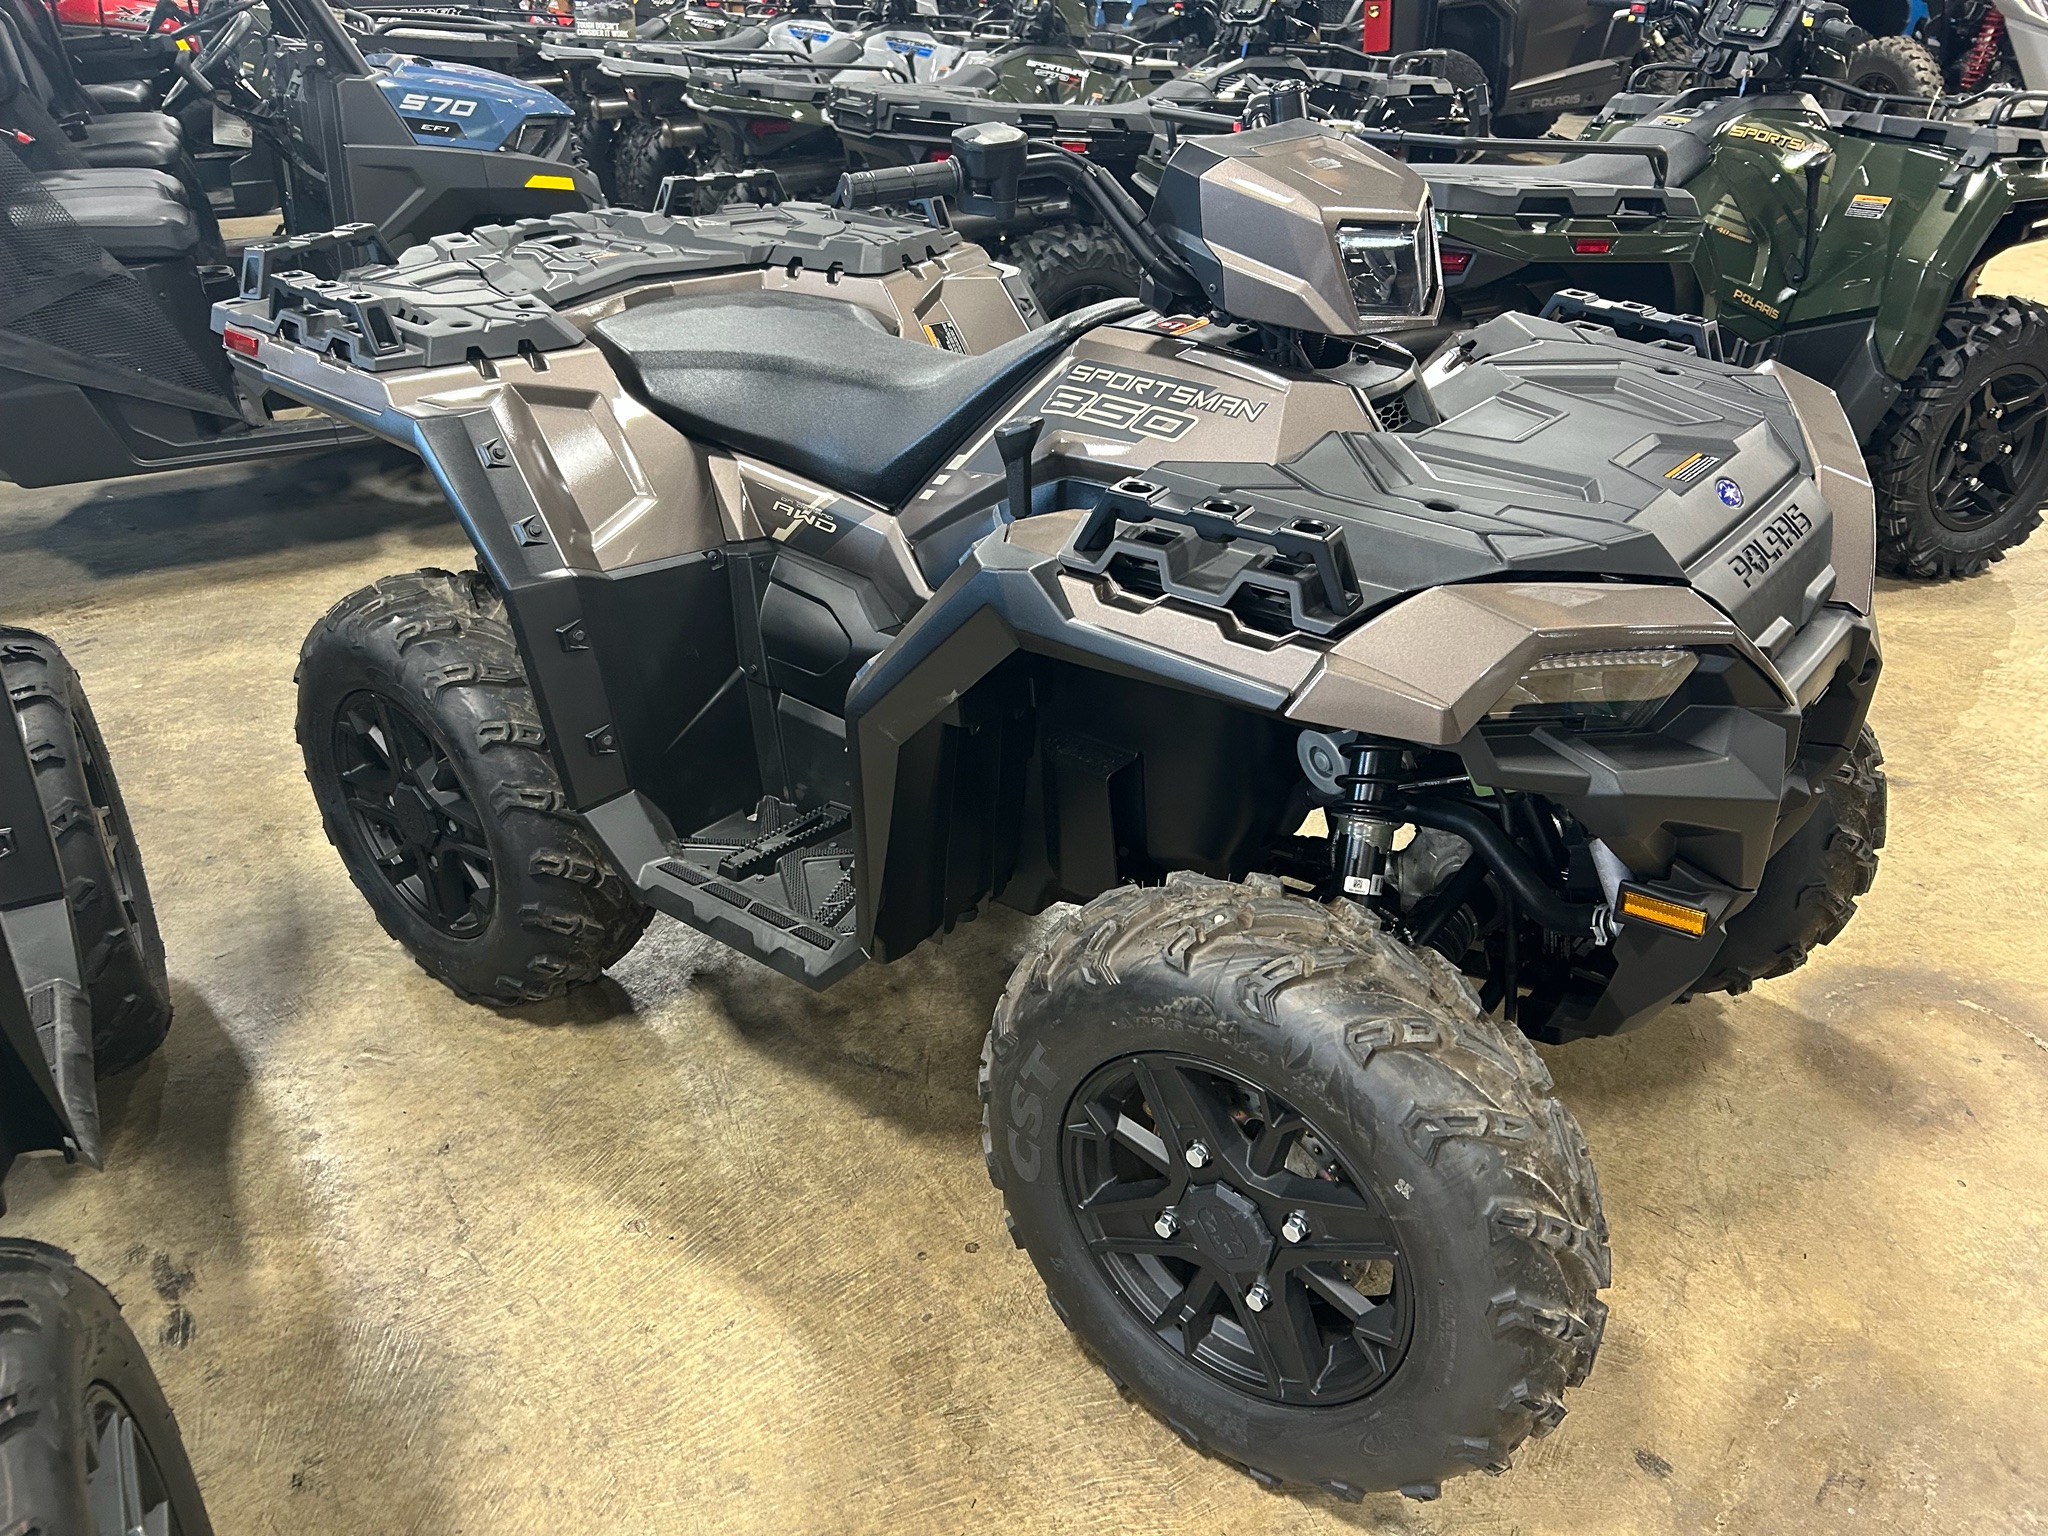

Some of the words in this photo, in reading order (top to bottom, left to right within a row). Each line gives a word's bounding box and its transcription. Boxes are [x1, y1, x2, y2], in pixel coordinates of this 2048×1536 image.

[399, 93, 478, 117] 570
[1531, 94, 1580, 108] POLARIS
[421, 123, 450, 133] EFI
[1733, 289, 1780, 320] POLARIS
[1067, 364, 1271, 423] SPORTSMAN
[1040, 384, 1200, 443] 850
[772, 500, 838, 534] AWD
[1728, 503, 1813, 588] POLARIS
[1007, 1040, 1060, 1183] CST
